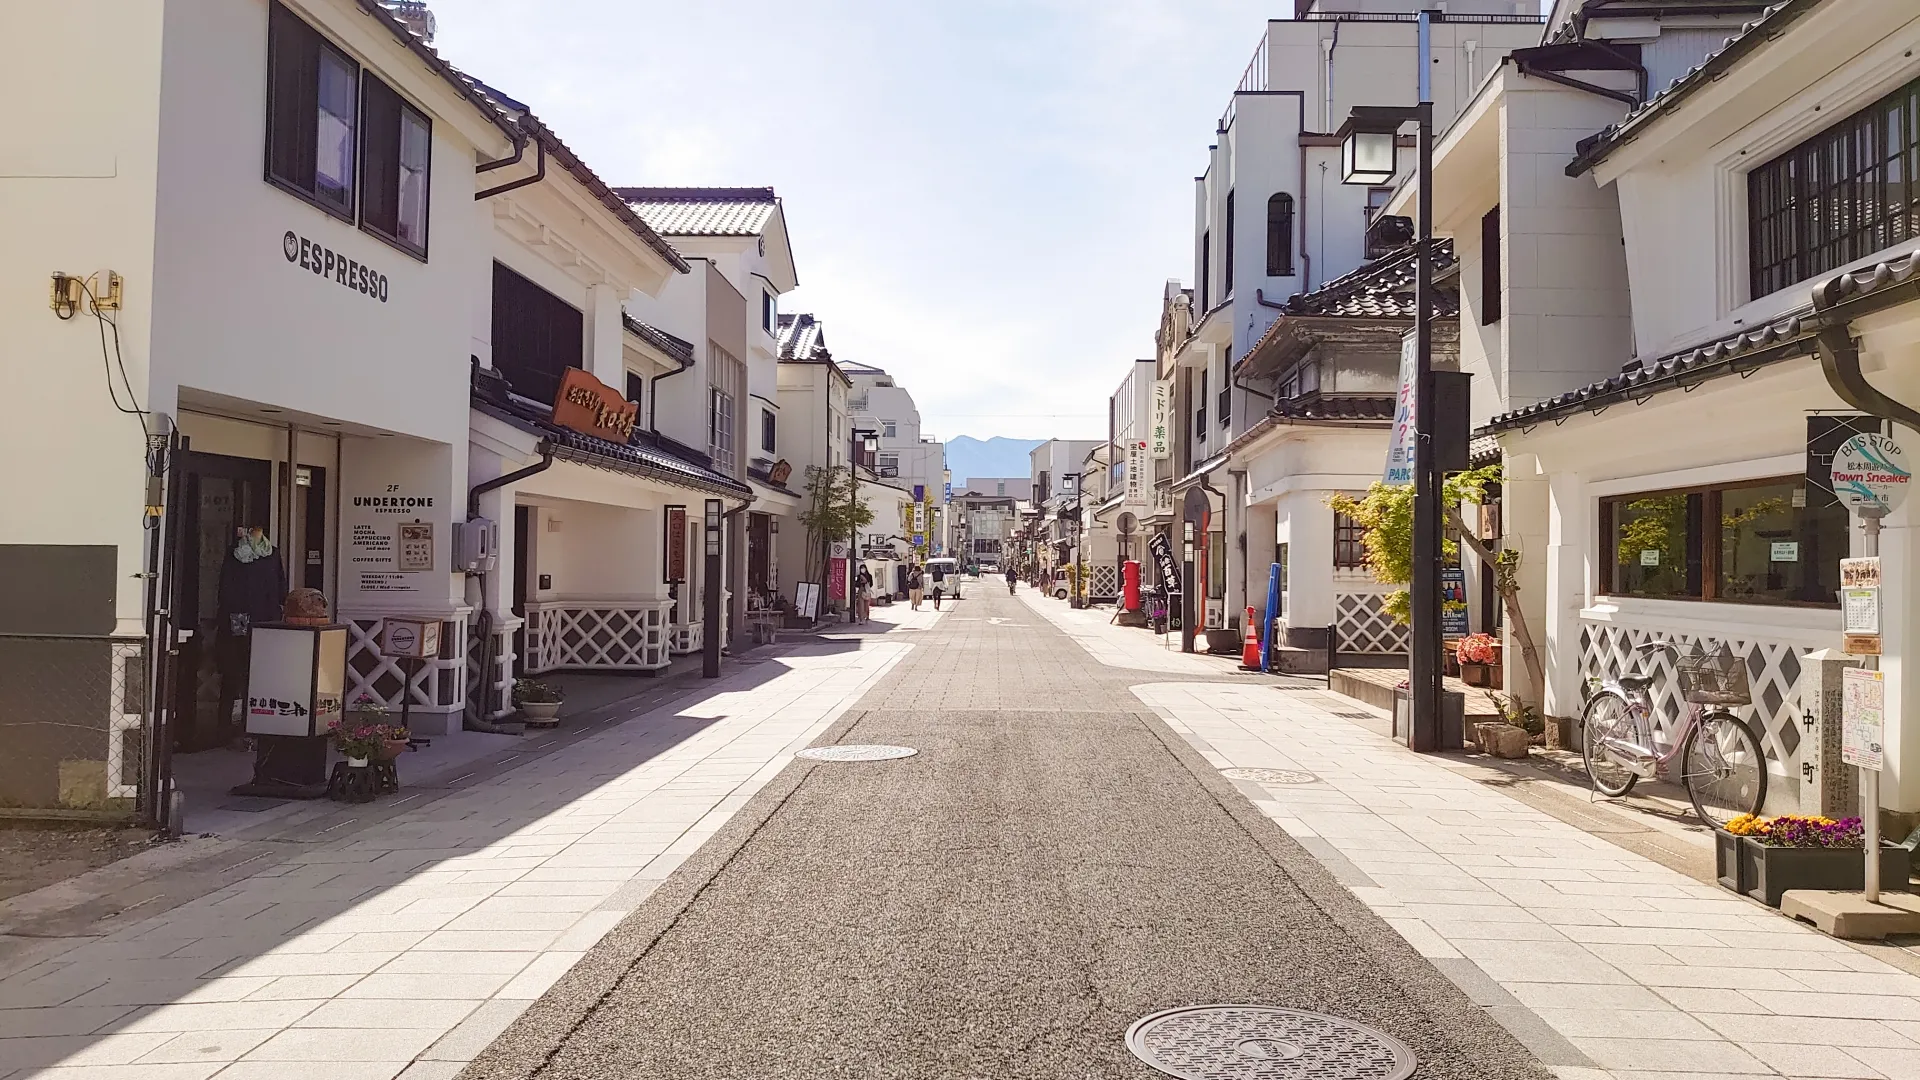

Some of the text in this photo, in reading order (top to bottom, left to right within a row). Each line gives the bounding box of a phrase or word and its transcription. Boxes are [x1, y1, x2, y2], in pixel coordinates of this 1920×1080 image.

[1153, 385, 1166, 453] ミドリ薬品
[1841, 435, 1902, 457] BUS STOP
[1832, 471, 1911, 483] Town Sneaker
[386, 484, 399, 492] 2F
[353, 496, 433, 507] UNDERTONE
[1802, 707, 1815, 784] 中町
